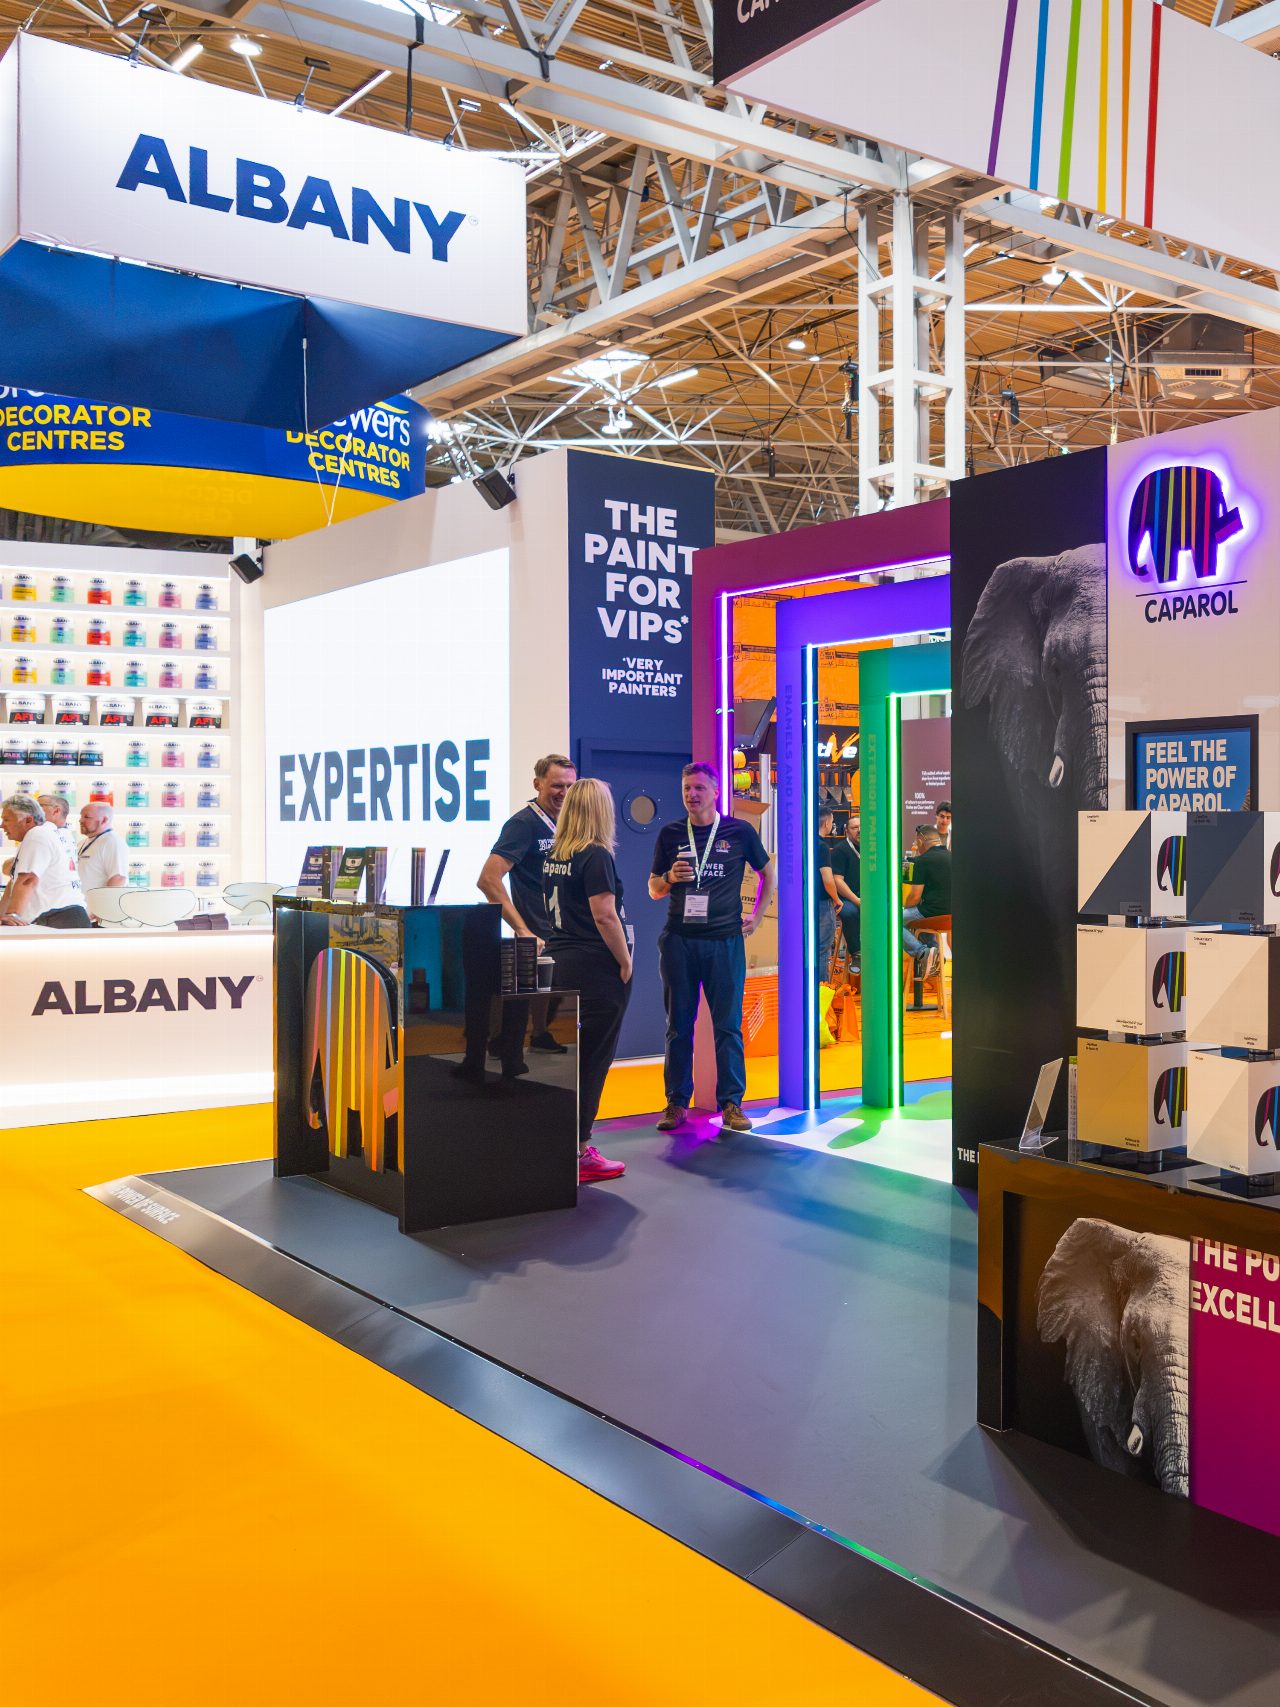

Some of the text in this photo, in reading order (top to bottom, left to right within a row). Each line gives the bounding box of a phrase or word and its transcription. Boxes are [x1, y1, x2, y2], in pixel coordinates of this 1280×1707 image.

[116, 133, 467, 262] ALBANY
[7, 429, 125, 452] CENTRES
[308, 451, 401, 489] CENTRES
[604, 499, 678, 538] THE
[584, 532, 700, 575] PAINT
[606, 571, 681, 609] FOR
[1144, 590, 1239, 624] CAPAROL
[602, 669, 683, 685] IMPORTANT
[609, 682, 677, 697] PAINTERS
[1145, 737, 1227, 765] FEEL THE
[279, 738, 491, 823] EXPERTISE
[1145, 764, 1237, 790] POWER OF
[1145, 792, 1231, 811] CAPAROL.
[31, 975, 256, 1016] ALBANY
[957, 1146, 976, 1163] THE
[1190, 1235, 1239, 1273] THE
